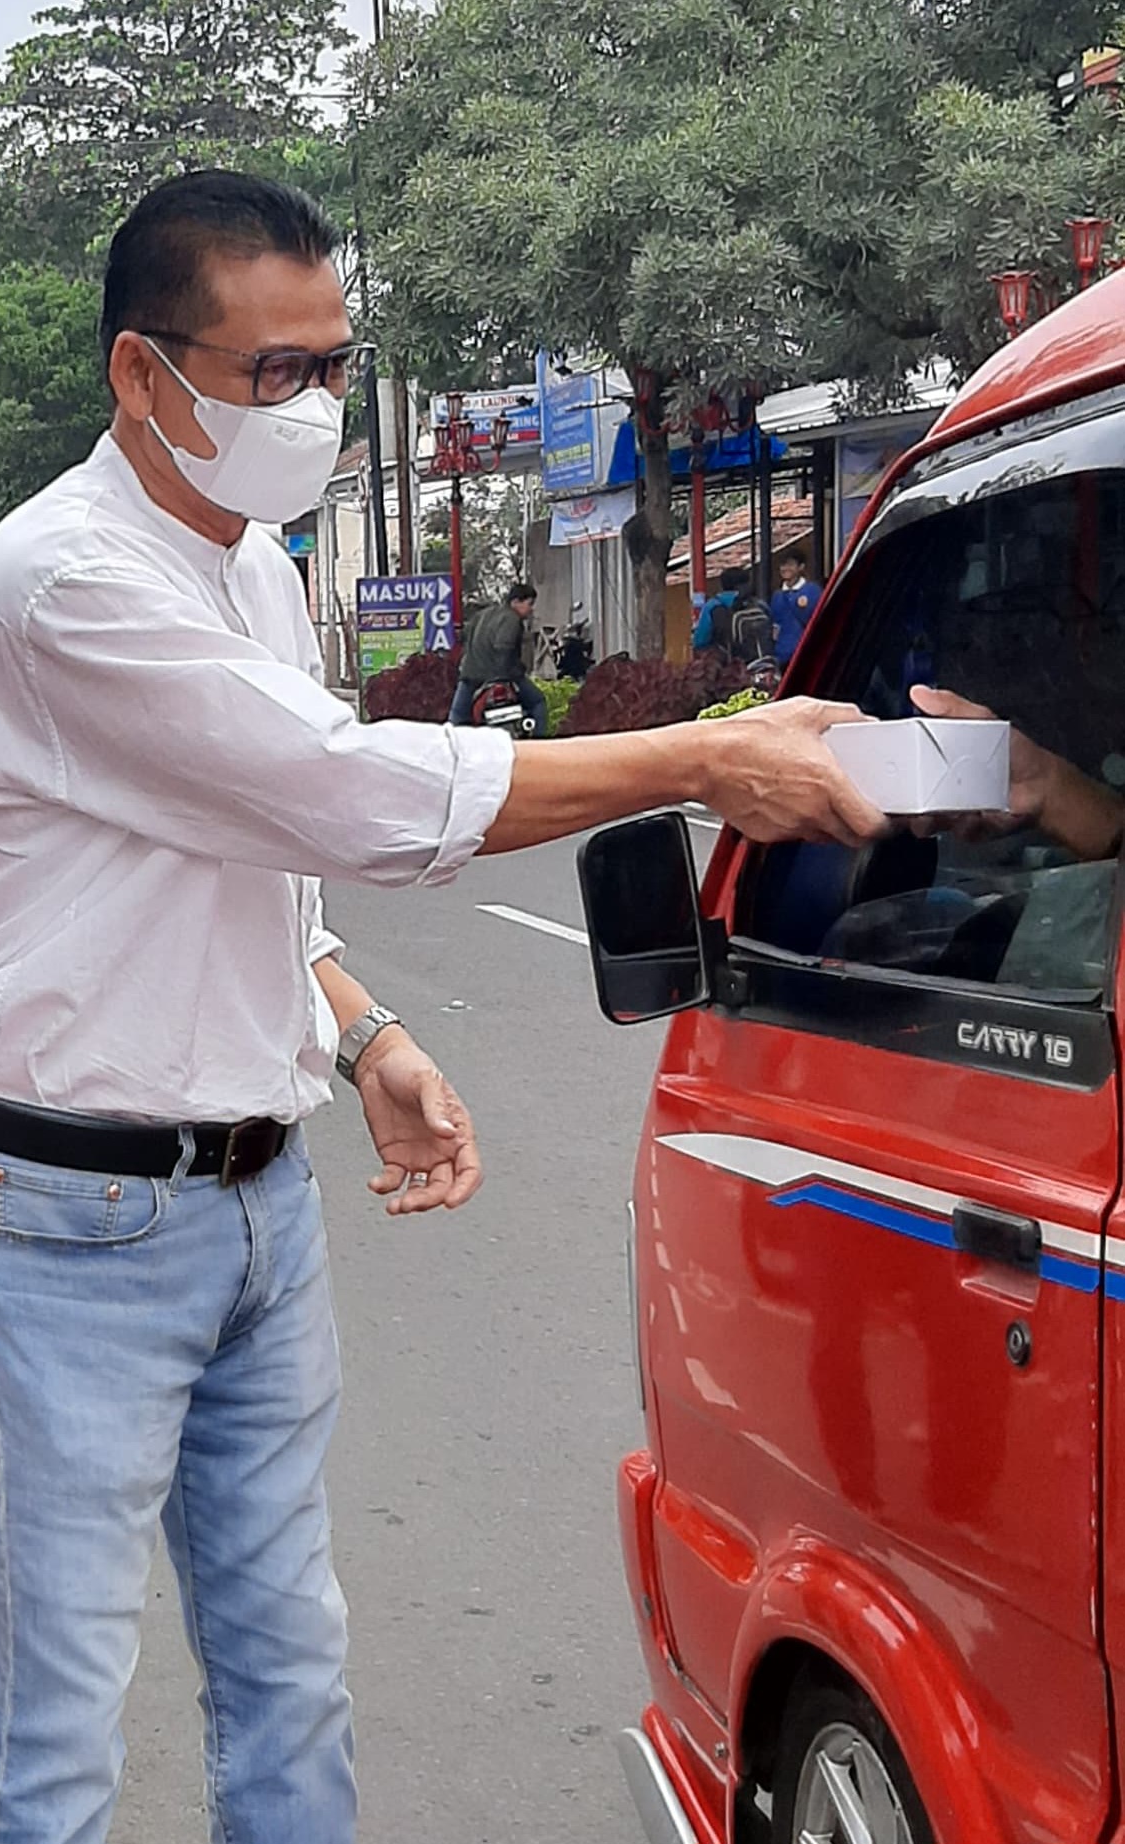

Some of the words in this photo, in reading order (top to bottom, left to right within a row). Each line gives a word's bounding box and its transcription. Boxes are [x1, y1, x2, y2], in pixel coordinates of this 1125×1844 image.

[360, 582, 435, 602] MASUK
[957, 1021, 1037, 1059] CARRY
[1043, 1033, 1073, 1068] 10
